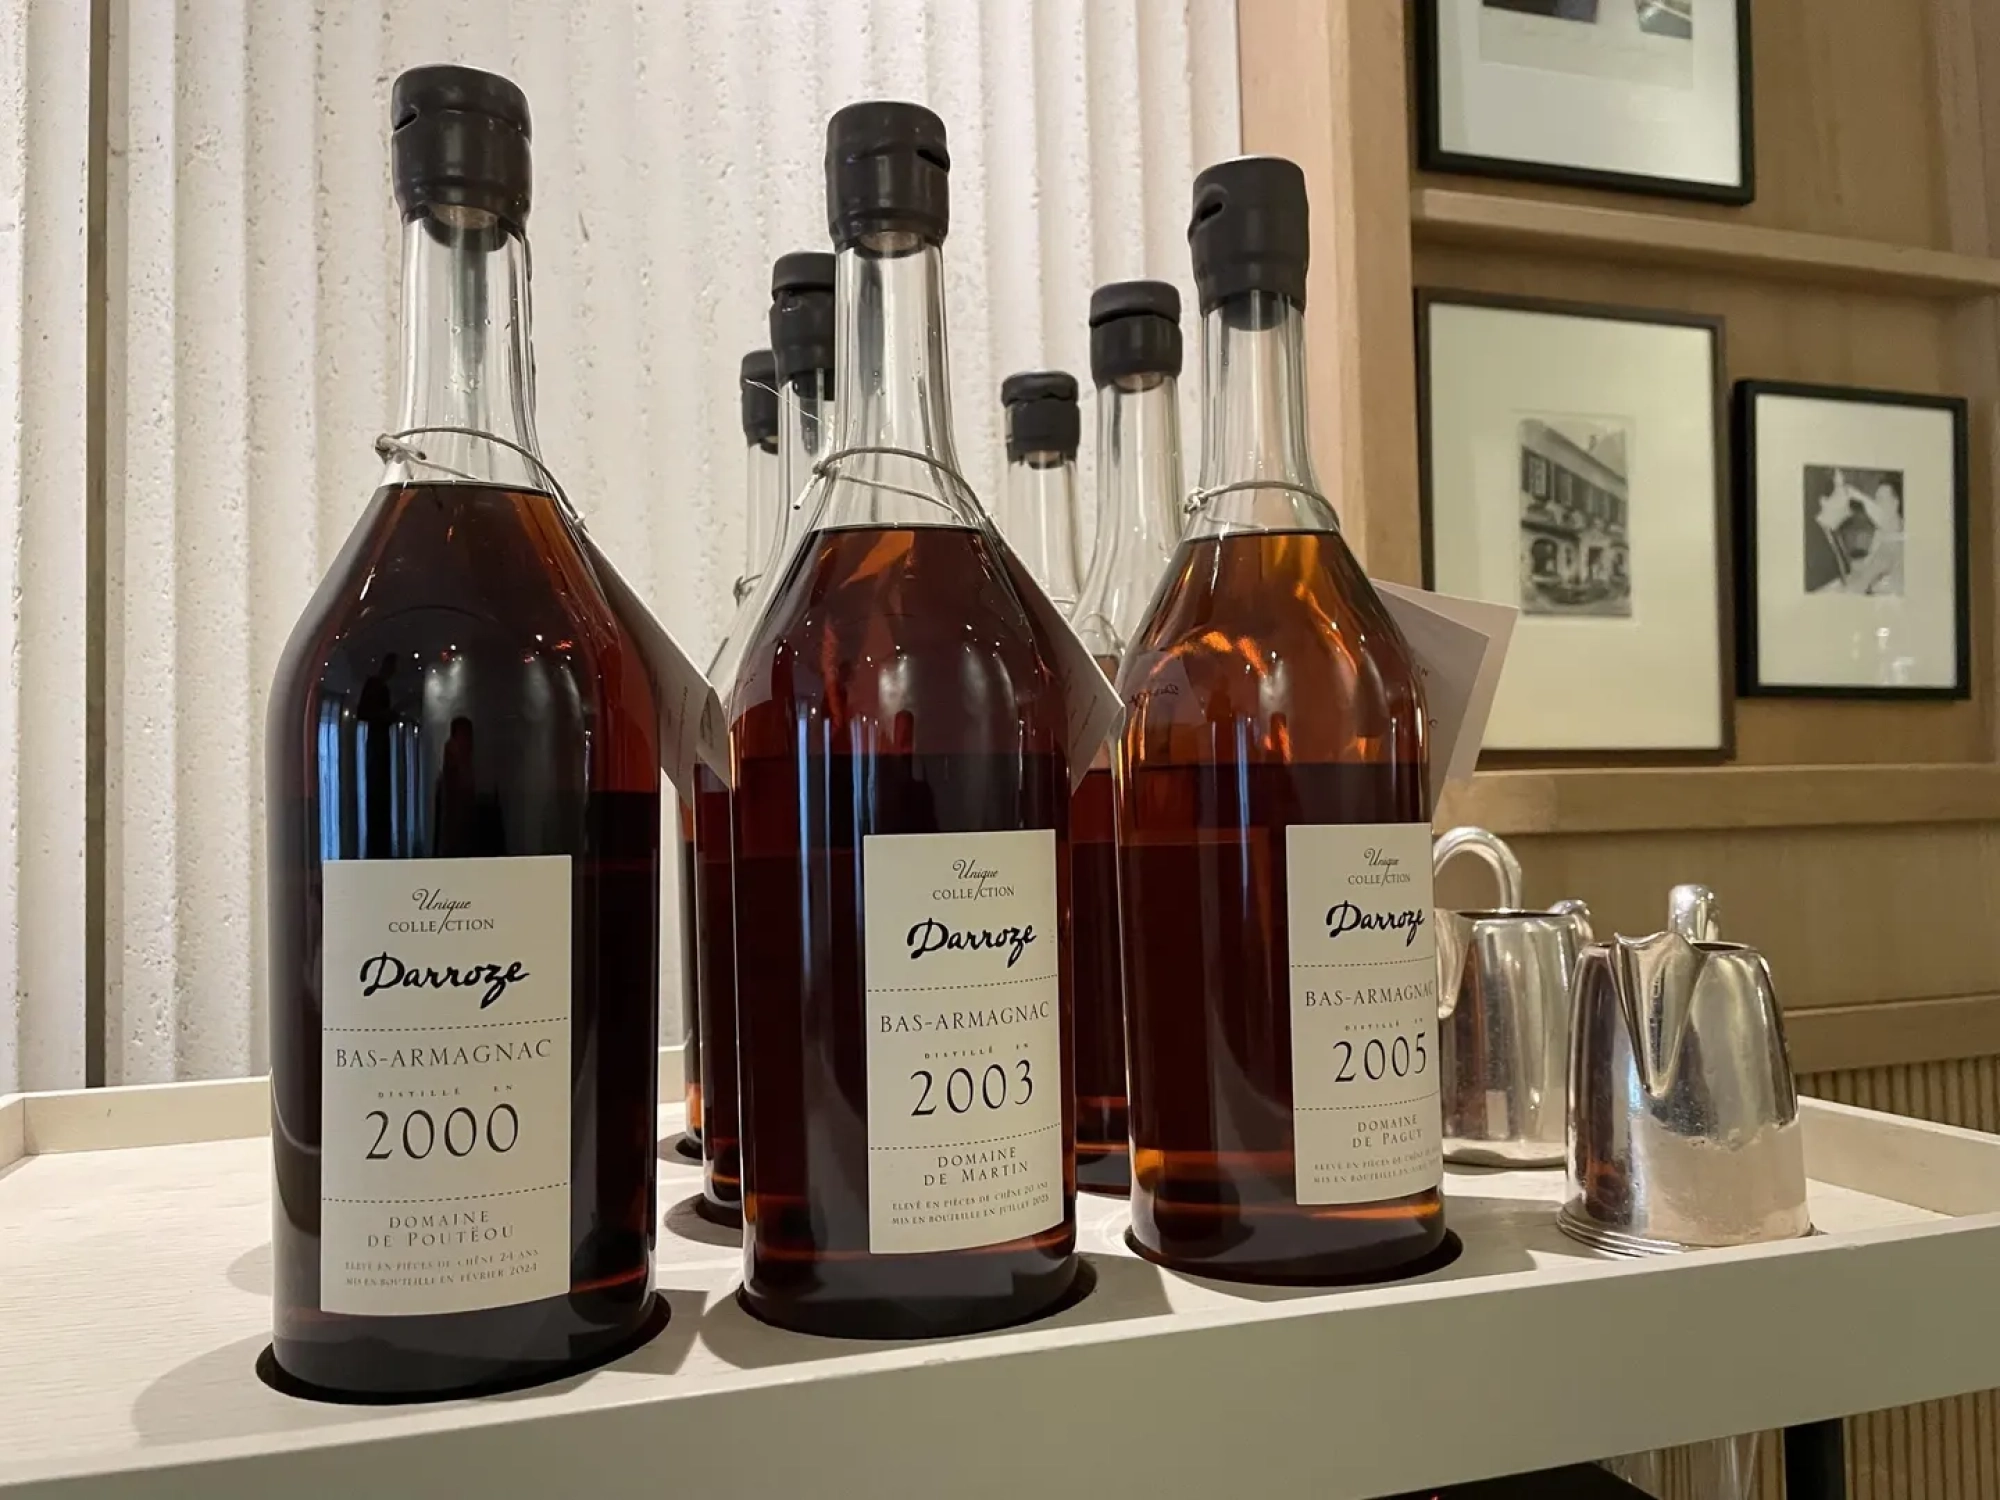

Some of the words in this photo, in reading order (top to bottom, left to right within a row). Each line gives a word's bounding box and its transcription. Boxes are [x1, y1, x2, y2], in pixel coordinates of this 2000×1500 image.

[952, 859, 998, 893] Unique
[1364, 848, 1400, 880] Unique
[1348, 873, 1411, 886] COLLECTION
[932, 885, 1015, 901] COLLECTION
[412, 888, 471, 926] Unique
[388, 918, 494, 933] COLLECTION
[1326, 900, 1425, 947] Darroze
[907, 917, 1037, 968] Darroze
[360, 951, 530, 1009] Darroze
[1306, 981, 1434, 1007] BAS-ARMAGNAC
[881, 1001, 1050, 1033] BAS-ARMAGNAC
[336, 1039, 552, 1068] BAS-ARMAGNAC
[1333, 1032, 1427, 1083] 2005
[910, 1059, 1034, 1117] 2003
[364, 1103, 519, 1160] 2000
[1358, 1114, 1418, 1133] DOMAINE
[1352, 1136, 1372, 1148] DE
[938, 1147, 1016, 1169] DOMAINE
[924, 1173, 948, 1187] DE
[961, 1161, 1028, 1183] MARTIN
[926, 1200, 940, 1209] EN
[389, 1210, 490, 1229] DOMAINE
[367, 1234, 394, 1248] DE
[509, 1262, 537, 1275] 2024
